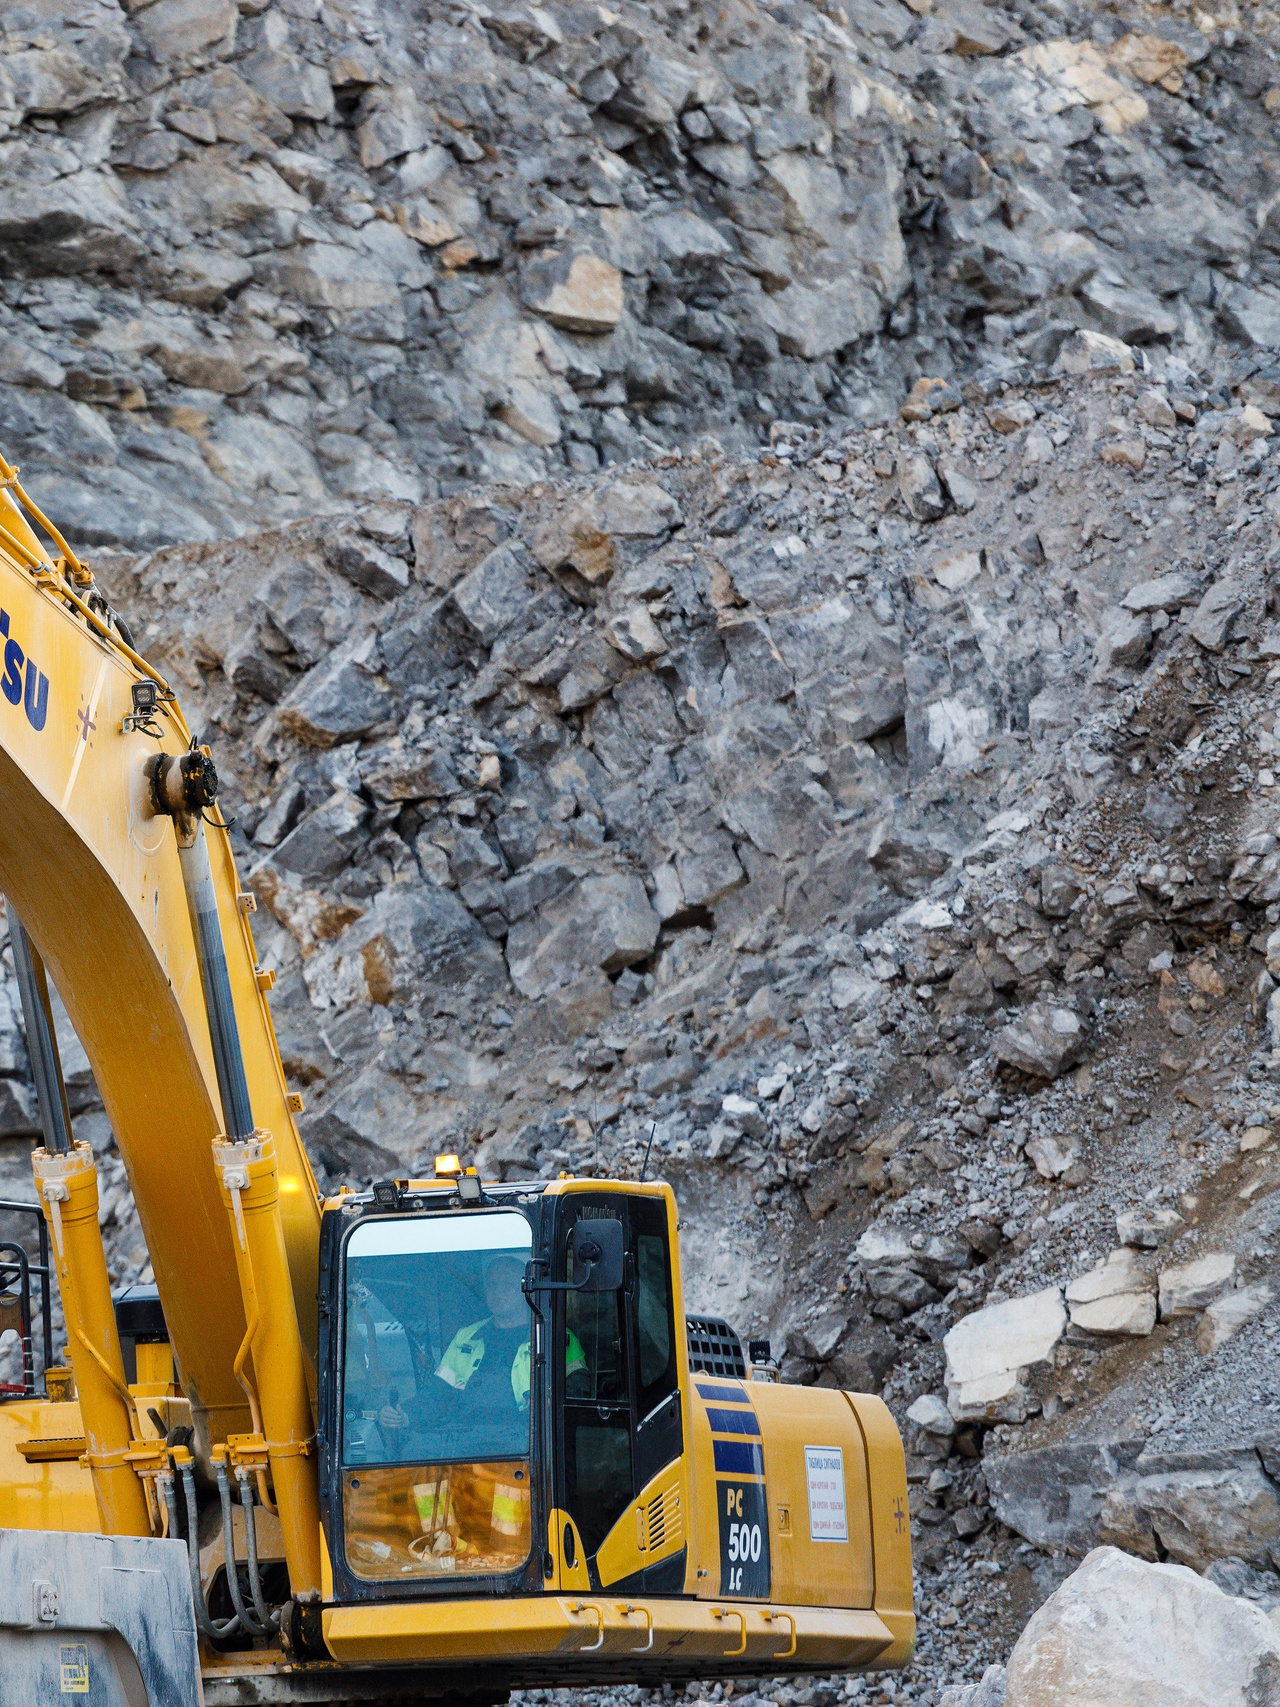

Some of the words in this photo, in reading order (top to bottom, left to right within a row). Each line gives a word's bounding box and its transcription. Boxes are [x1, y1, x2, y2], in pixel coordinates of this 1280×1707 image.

[727, 1488, 743, 1517] PC
[728, 1523, 762, 1563] 500
[729, 1567, 743, 1591] LC
